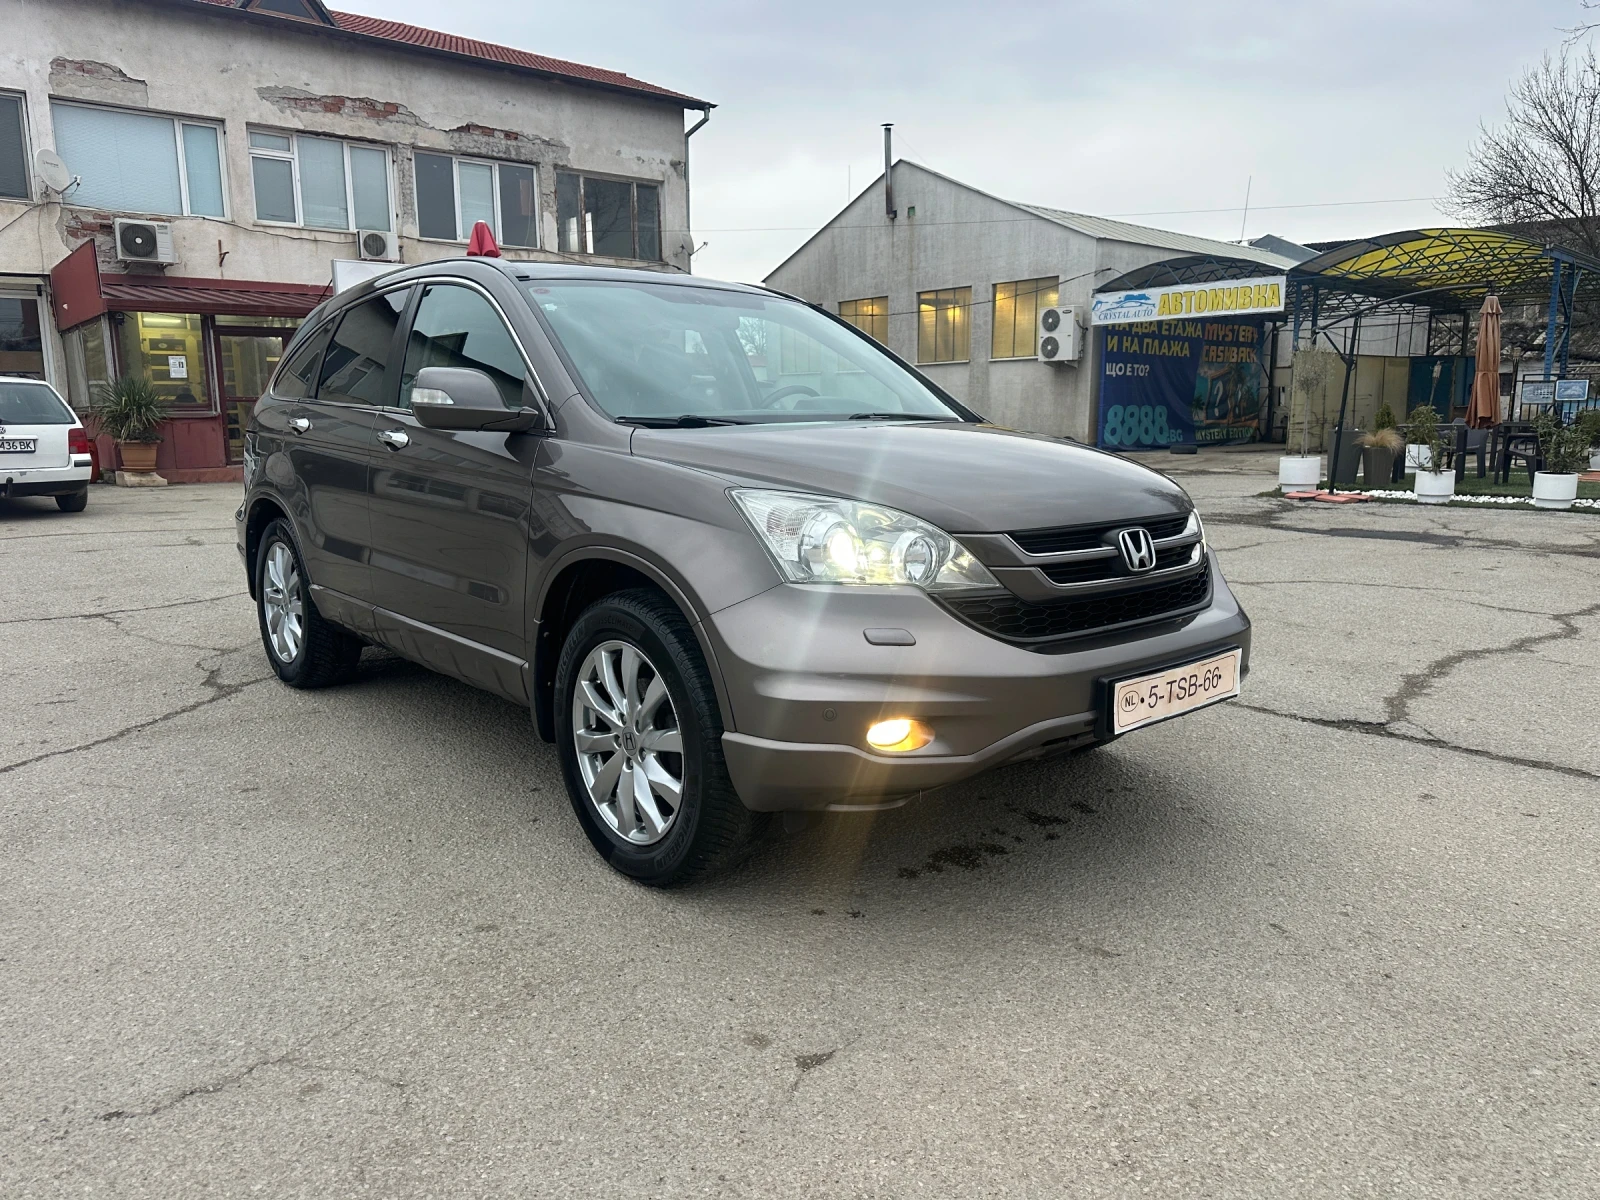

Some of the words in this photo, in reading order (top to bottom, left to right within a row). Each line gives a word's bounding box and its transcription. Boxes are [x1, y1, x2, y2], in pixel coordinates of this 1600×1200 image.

[1157, 283, 1280, 317] АВТОМИВКА
[1098, 311, 1131, 321] CRYSTAL
[1131, 308, 1153, 318] AUTO
[1132, 321, 1158, 335] ДВА
[1161, 319, 1203, 338] ЕТАЖА
[1204, 322, 1258, 343] MYSTERY
[1107, 335, 1118, 352] И
[1122, 336, 1140, 354] НА
[1142, 338, 1190, 357] ПЛАЖА
[1202, 345, 1258, 363] CASHBACK
[1105, 362, 1125, 377] ЩО
[1133, 363, 1150, 377] ТО?
[1195, 428, 1227, 441] MYSTERY
[19, 441, 33, 450] BK
[1124, 696, 1136, 708] NL
[1148, 666, 1220, 709] 5-TSB-66
[656, 811, 692, 870] MICHELIN
